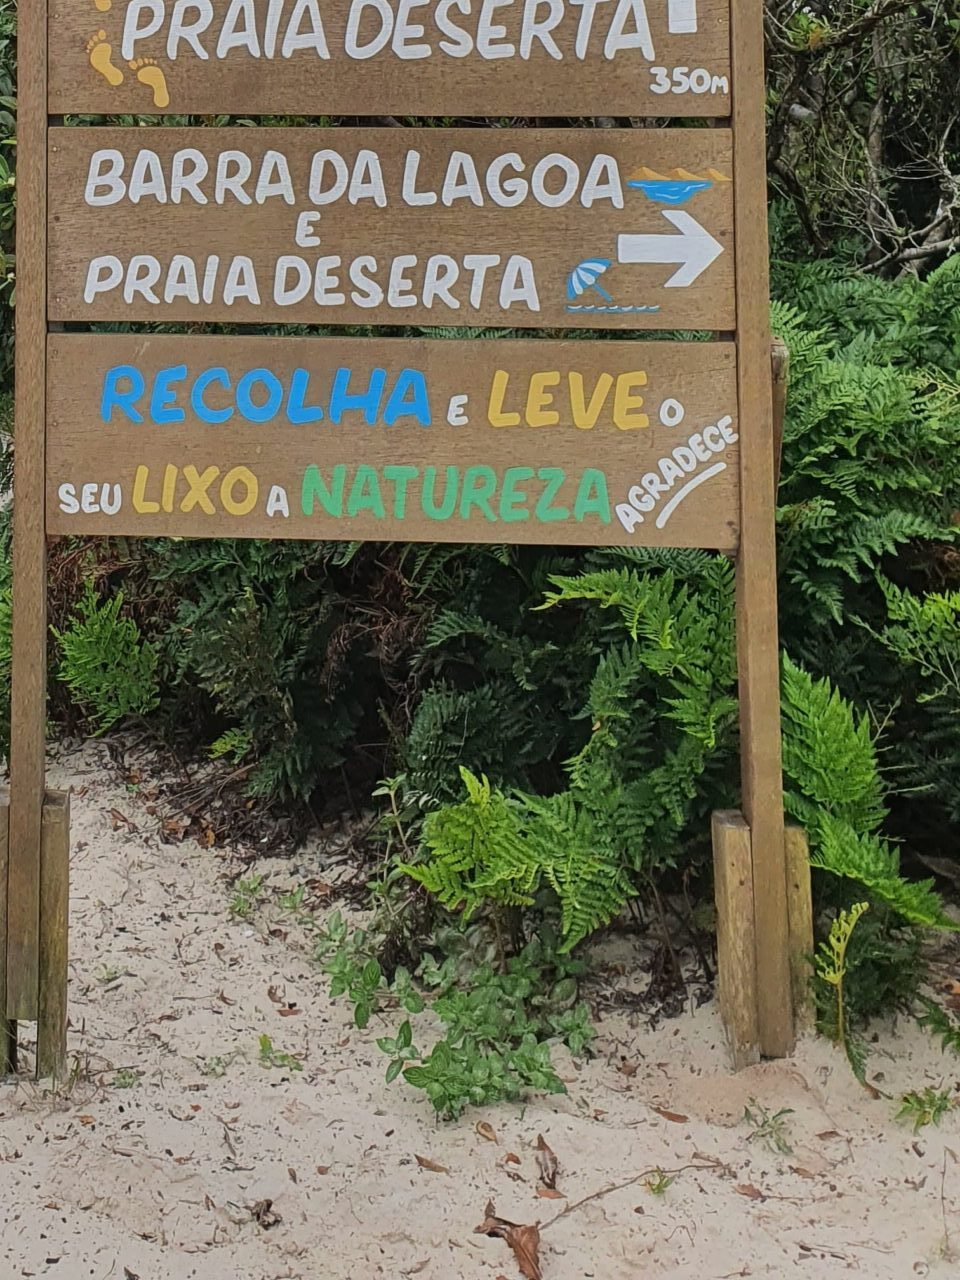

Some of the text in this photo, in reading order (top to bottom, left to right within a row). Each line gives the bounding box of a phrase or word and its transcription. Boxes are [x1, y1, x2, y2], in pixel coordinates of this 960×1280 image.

[83, 148, 625, 210] BARRA DA LAGOA
[295, 211, 322, 248] E
[83, 254, 540, 311] PRAIA DESERTA
[100, 364, 685, 430] RECOLHA E LEVE O
[58, 415, 739, 534] SEU LIXO A NATUREZA AGRADECE
